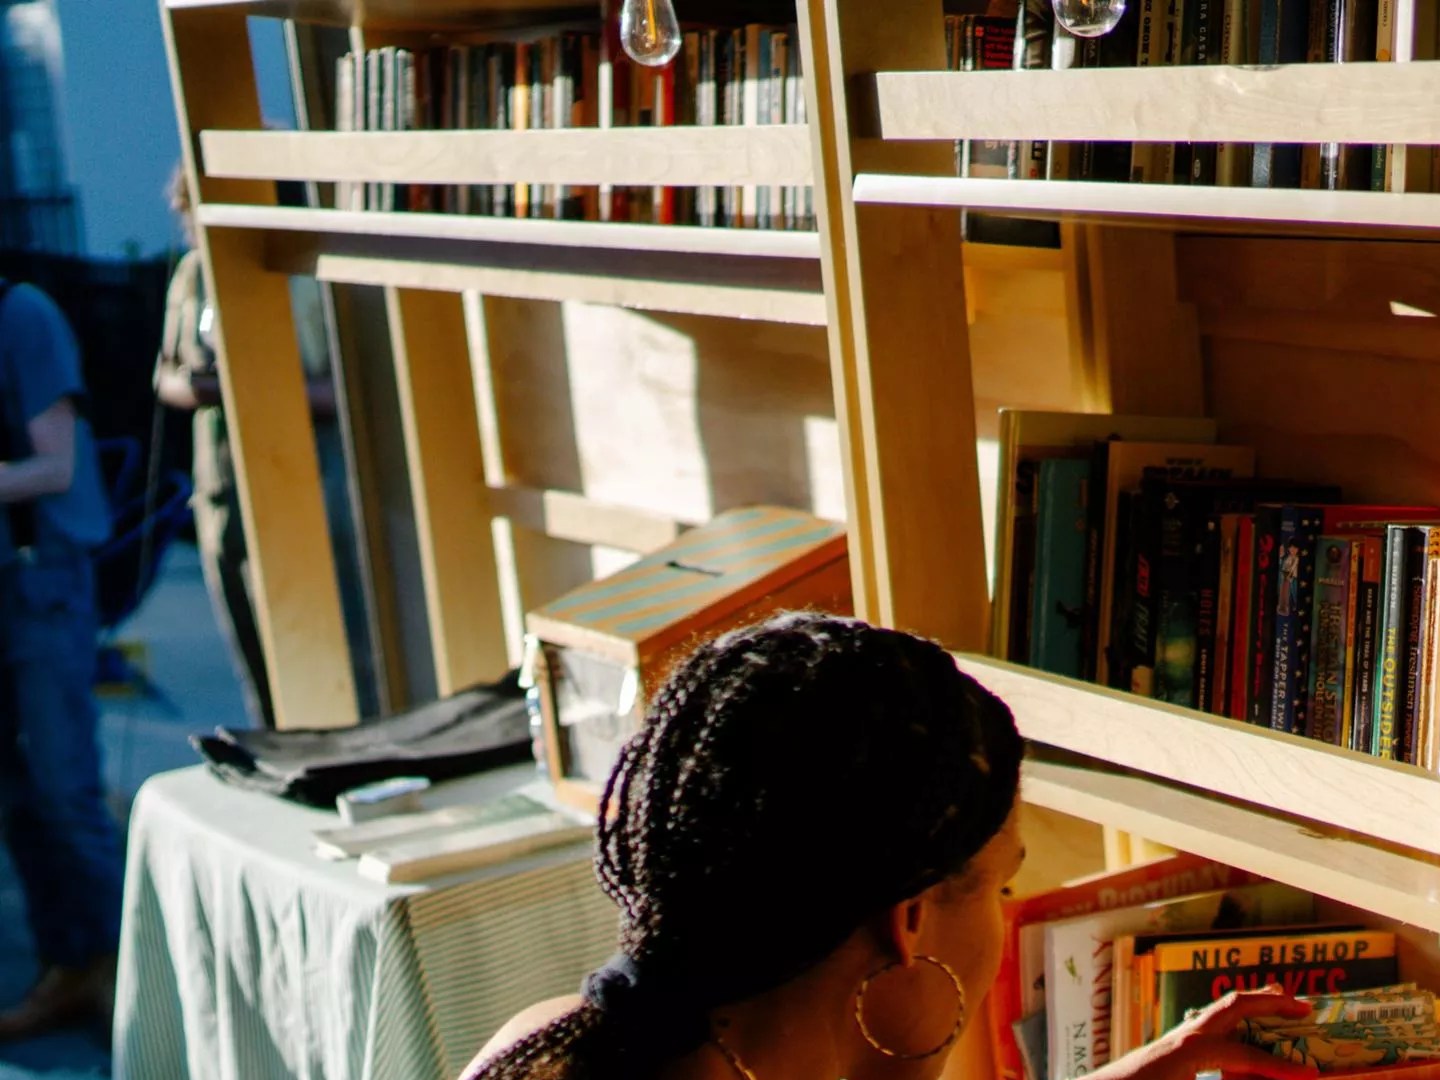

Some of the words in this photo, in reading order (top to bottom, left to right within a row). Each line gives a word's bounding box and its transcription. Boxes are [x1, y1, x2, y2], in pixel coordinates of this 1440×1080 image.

[1384, 627, 1395, 654] THE
[1277, 645, 1287, 696] TAPPER
[1405, 646, 1417, 710] freshmen
[1314, 672, 1324, 701] HOLE
[1192, 946, 1241, 970] NIC
[1260, 940, 1370, 964] BISHOP
